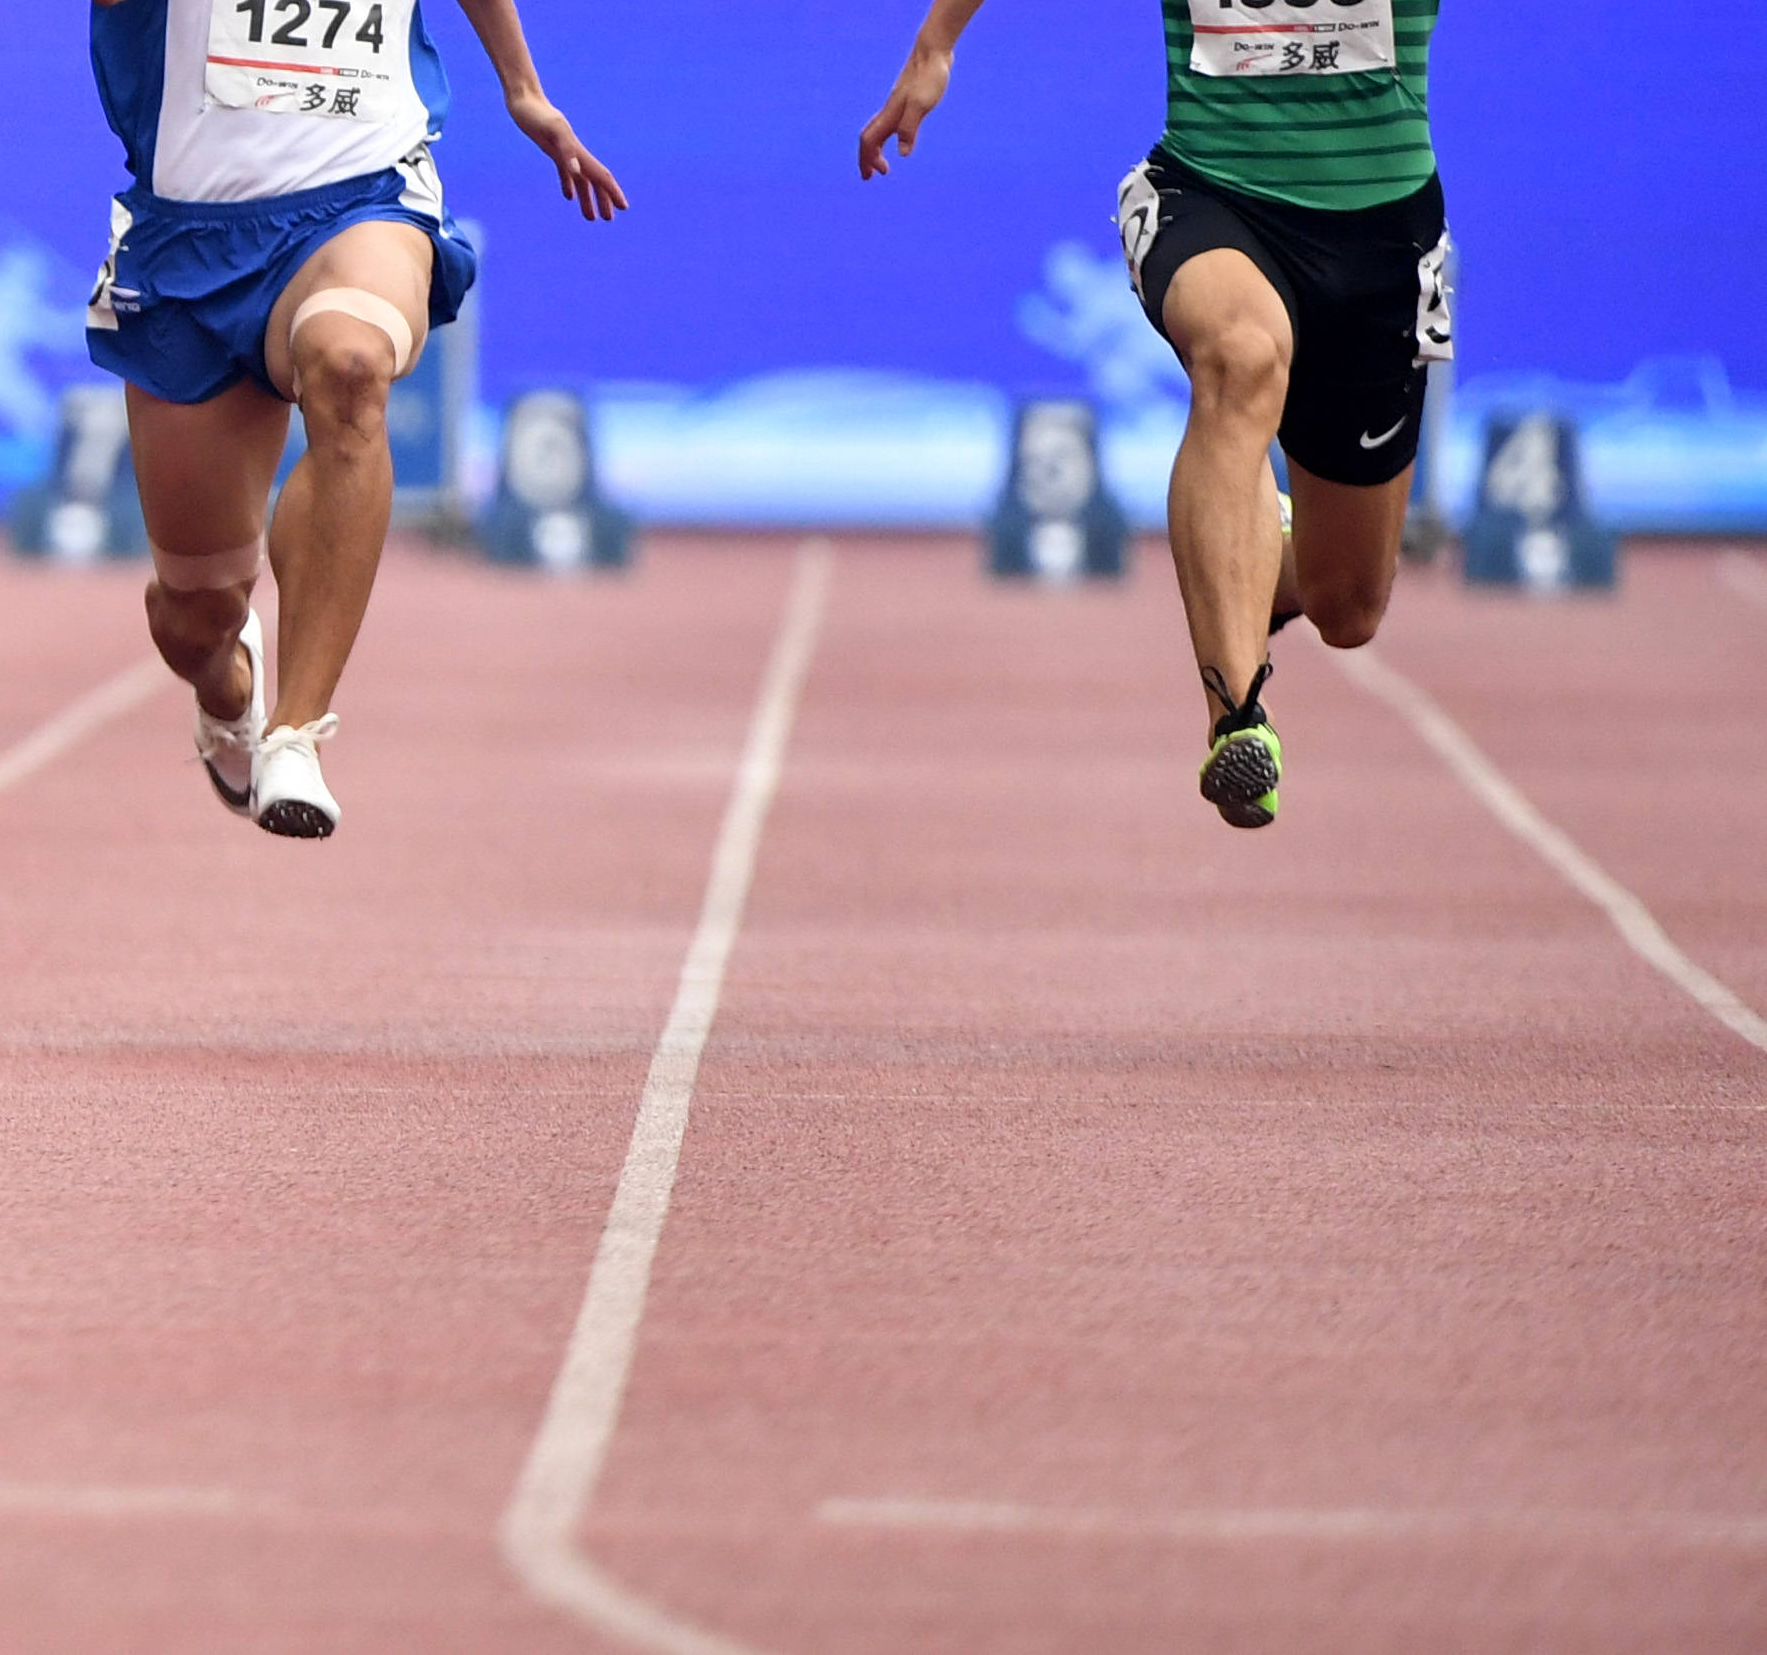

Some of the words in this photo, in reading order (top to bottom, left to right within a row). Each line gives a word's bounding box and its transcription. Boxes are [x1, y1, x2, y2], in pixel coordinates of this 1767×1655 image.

[1279, 40, 1340, 72] 多威
[300, 83, 360, 117] 多威
[1485, 414, 1562, 512] 4
